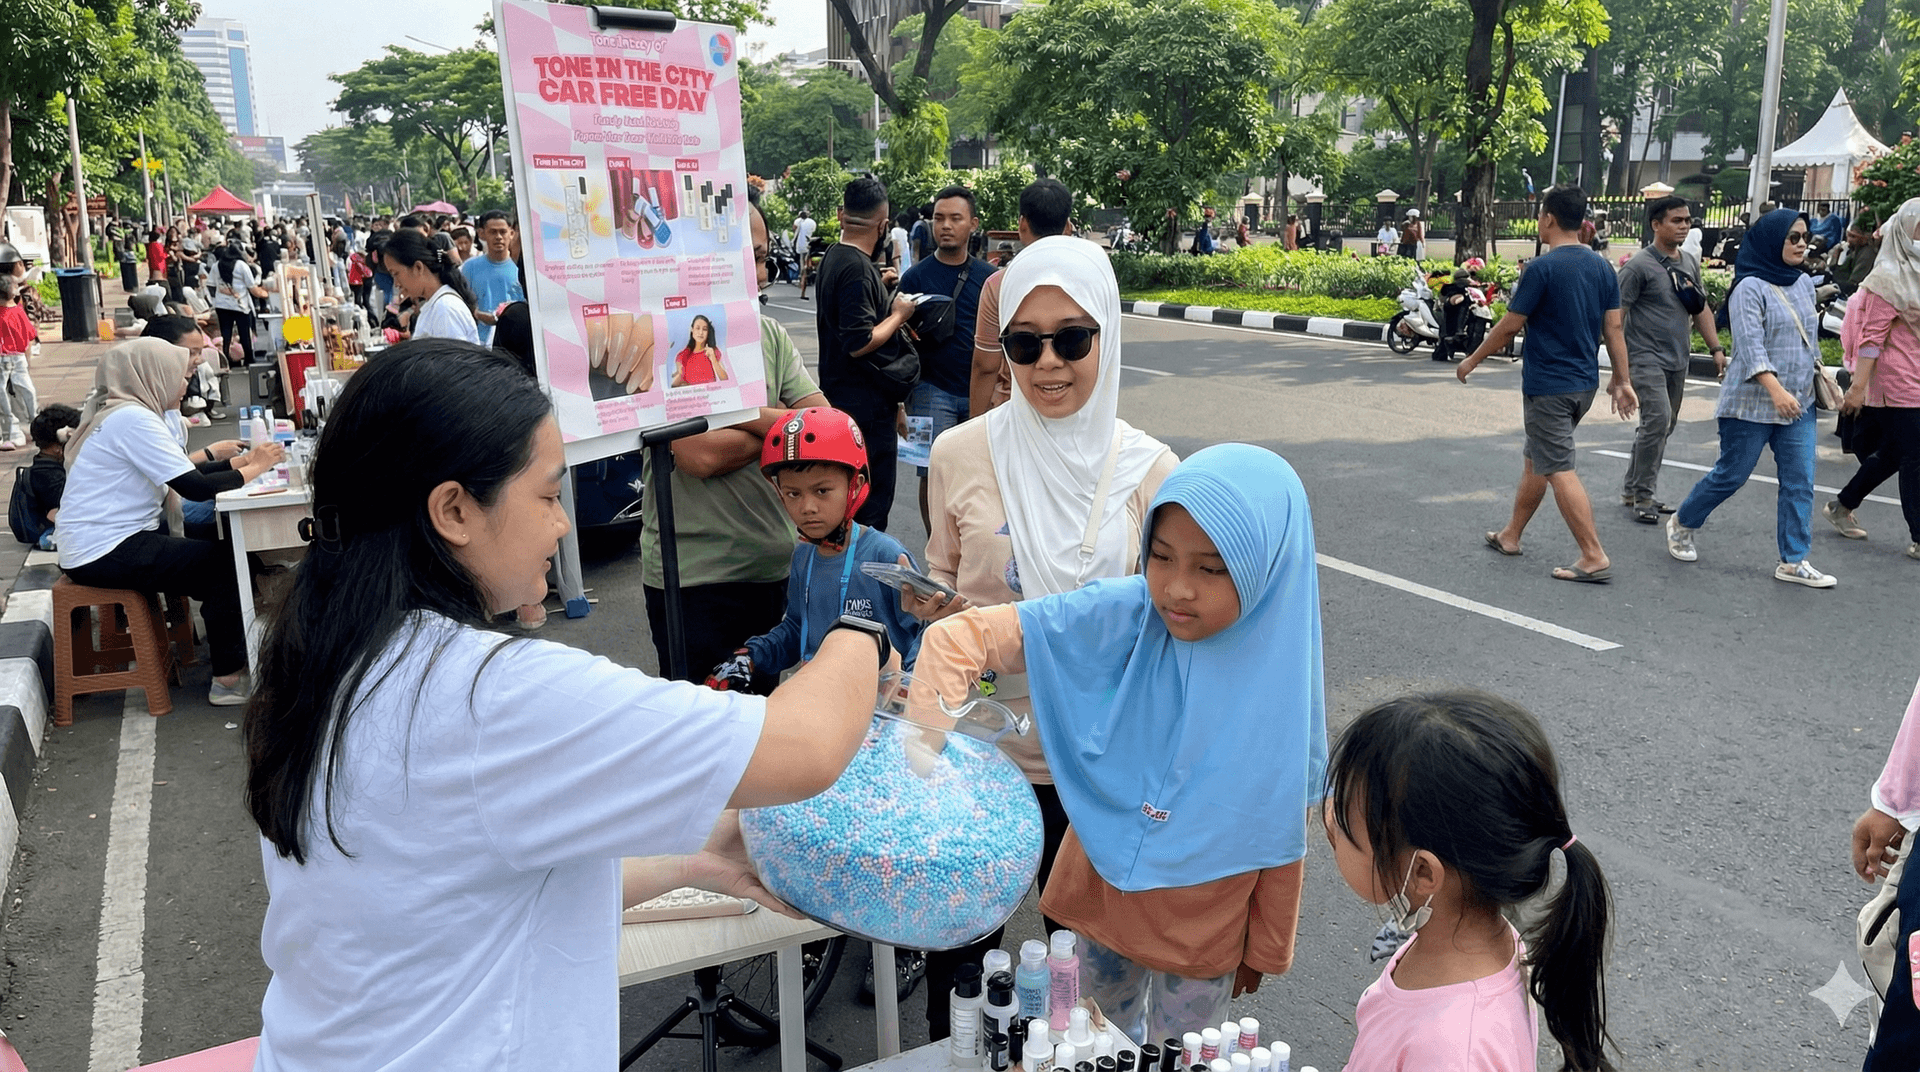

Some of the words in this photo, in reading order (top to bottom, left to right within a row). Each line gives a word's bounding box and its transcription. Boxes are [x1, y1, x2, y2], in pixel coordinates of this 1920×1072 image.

[533, 56, 593, 78] TONE
[595, 58, 622, 79] IN
[624, 59, 661, 82] THE
[665, 65, 714, 91] CITY
[538, 79, 596, 104] CAR
[599, 82, 657, 108] FREE
[660, 86, 707, 112] DAY
